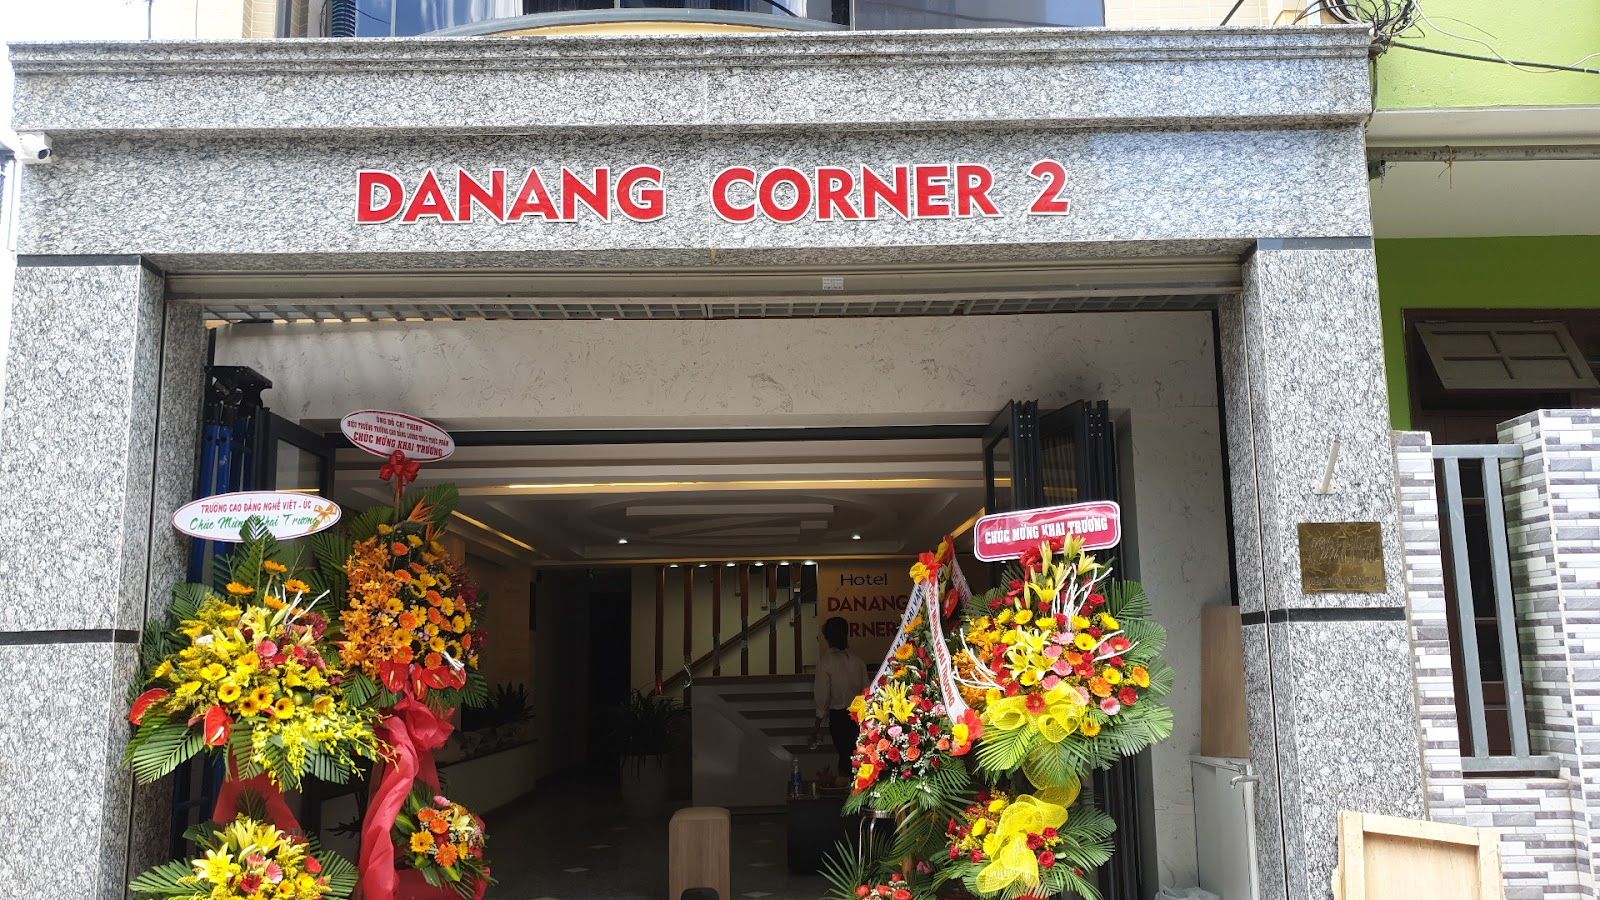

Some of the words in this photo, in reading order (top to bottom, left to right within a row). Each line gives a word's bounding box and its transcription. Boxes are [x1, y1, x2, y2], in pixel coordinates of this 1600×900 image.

[356, 164, 667, 225] DANANG
[710, 162, 1004, 224] CORNER
[1027, 159, 1072, 216] 2
[353, 431, 374, 444] CHÚC
[375, 435, 396, 448] MỪNG
[397, 440, 414, 452] KHAI
[416, 442, 443, 457] TRƯƠNG
[201, 502, 227, 514] TRƯỜNG
[229, 503, 242, 512] CAO
[302, 499, 312, 509] ÚC
[189, 516, 214, 531] Chúc
[984, 527, 1010, 545] CHÚC
[1012, 523, 1039, 541] MỪNG
[1042, 521, 1065, 538] KHAI
[1067, 515, 1108, 535] TRƯƠNG
[840, 573, 888, 586] Hotel
[827, 595, 908, 612] DANANG
